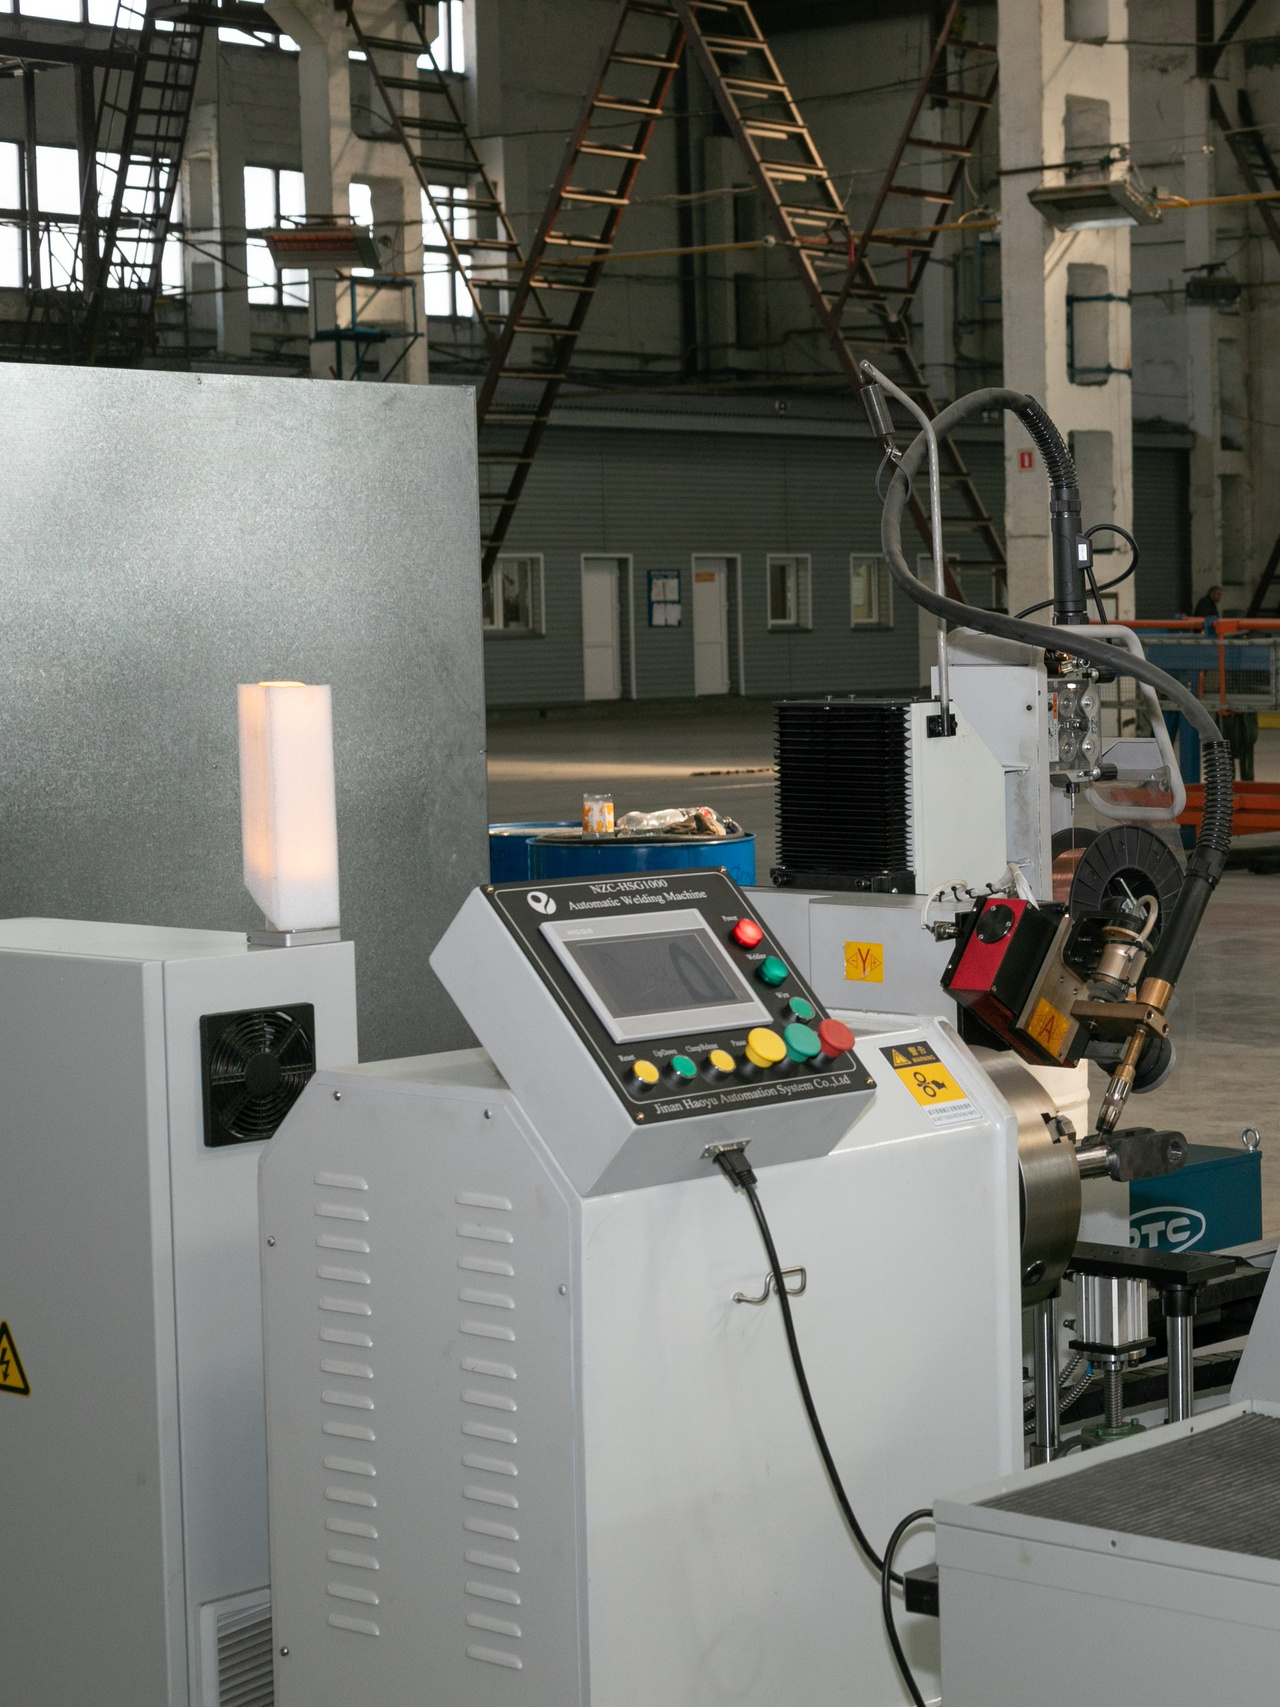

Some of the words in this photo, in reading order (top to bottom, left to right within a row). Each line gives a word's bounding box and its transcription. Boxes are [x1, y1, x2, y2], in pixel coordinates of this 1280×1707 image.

[589, 879, 668, 894] NZC-HSG1000
[568, 897, 620, 911] Automatic
[620, 893, 666, 905] Welding
[663, 889, 708, 902] Machine
[857, 947, 871, 977] Y
[1038, 1014, 1055, 1043] A
[911, 1054, 936, 1063] WARNING
[654, 1101, 683, 1115] Jinan
[684, 1097, 718, 1111] Haoyu
[719, 1086, 778, 1104] Automation
[776, 1080, 810, 1096] System
